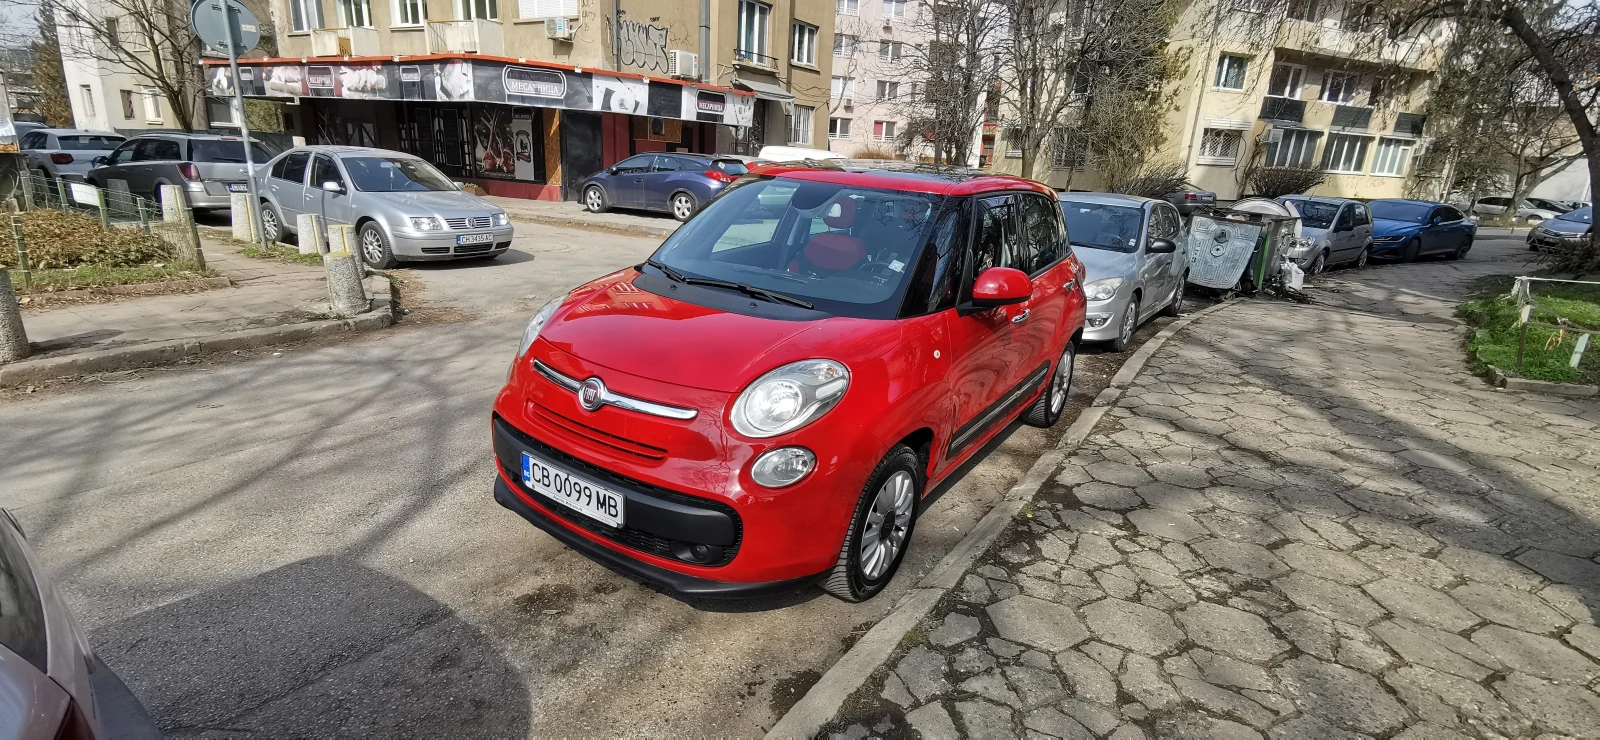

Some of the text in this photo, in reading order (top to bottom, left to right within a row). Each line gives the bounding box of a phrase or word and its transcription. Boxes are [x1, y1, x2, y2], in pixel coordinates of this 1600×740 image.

[584, 387, 596, 401] FIAT
[532, 462, 551, 488] CB
[554, 472, 592, 507] 0099
[596, 490, 619, 518] MB
